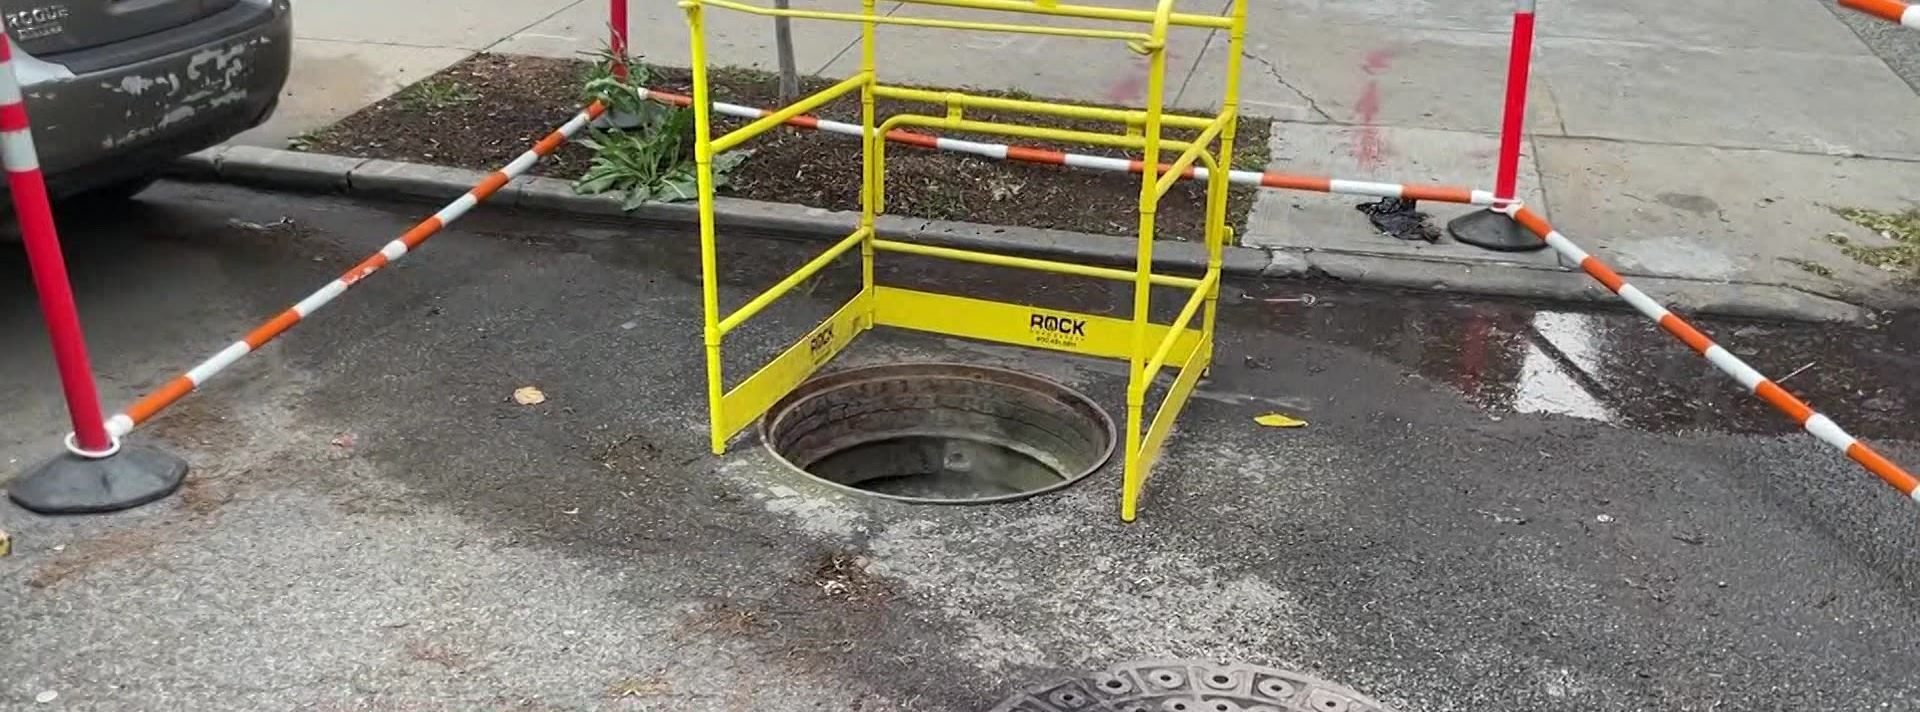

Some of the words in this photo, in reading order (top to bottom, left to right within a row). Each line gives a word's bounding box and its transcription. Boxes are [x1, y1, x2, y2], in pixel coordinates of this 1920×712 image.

[6, 5, 70, 27] ROGUE
[1031, 314, 1086, 336] ROCK
[811, 323, 833, 351] ROCK
